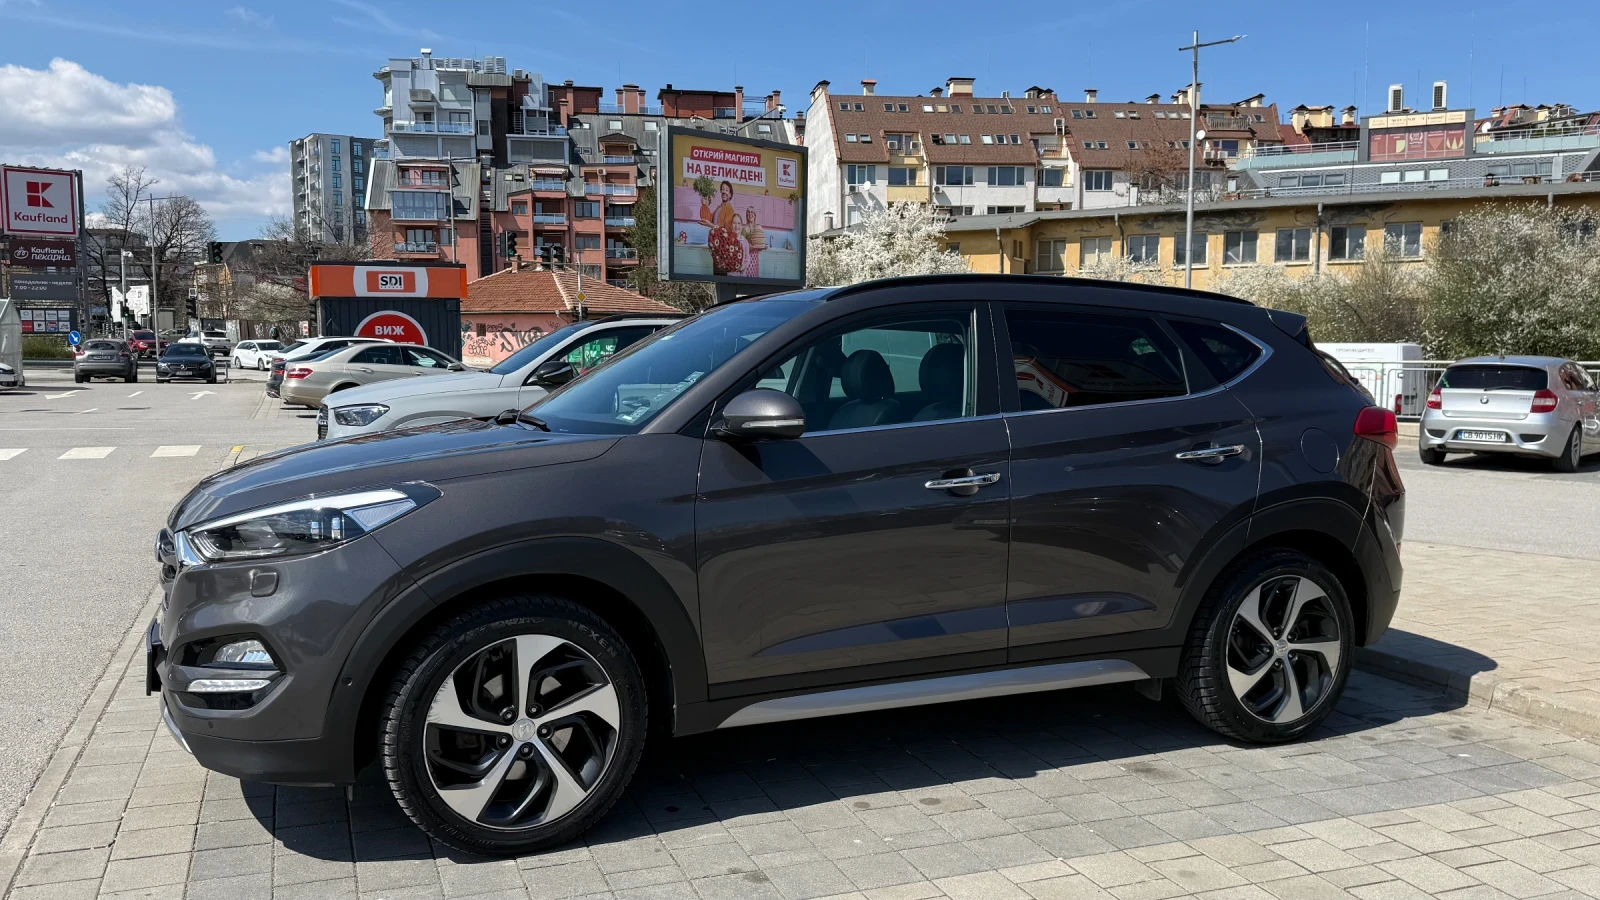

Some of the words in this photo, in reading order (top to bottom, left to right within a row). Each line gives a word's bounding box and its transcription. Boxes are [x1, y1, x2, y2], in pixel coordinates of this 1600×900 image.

[693, 149, 724, 160] ОТКРИЙ
[724, 153, 759, 165] МАГИЯТА
[686, 162, 702, 175] НА
[704, 164, 763, 182] ВЕЛИКДЕН!
[14, 211, 68, 224] Kaufland
[31, 246, 65, 254] Kaufland
[31, 254, 72, 262] пекарна
[380, 275, 402, 286] SDI
[374, 325, 405, 336] ВИЖ
[567, 619, 618, 658] NEXEN
